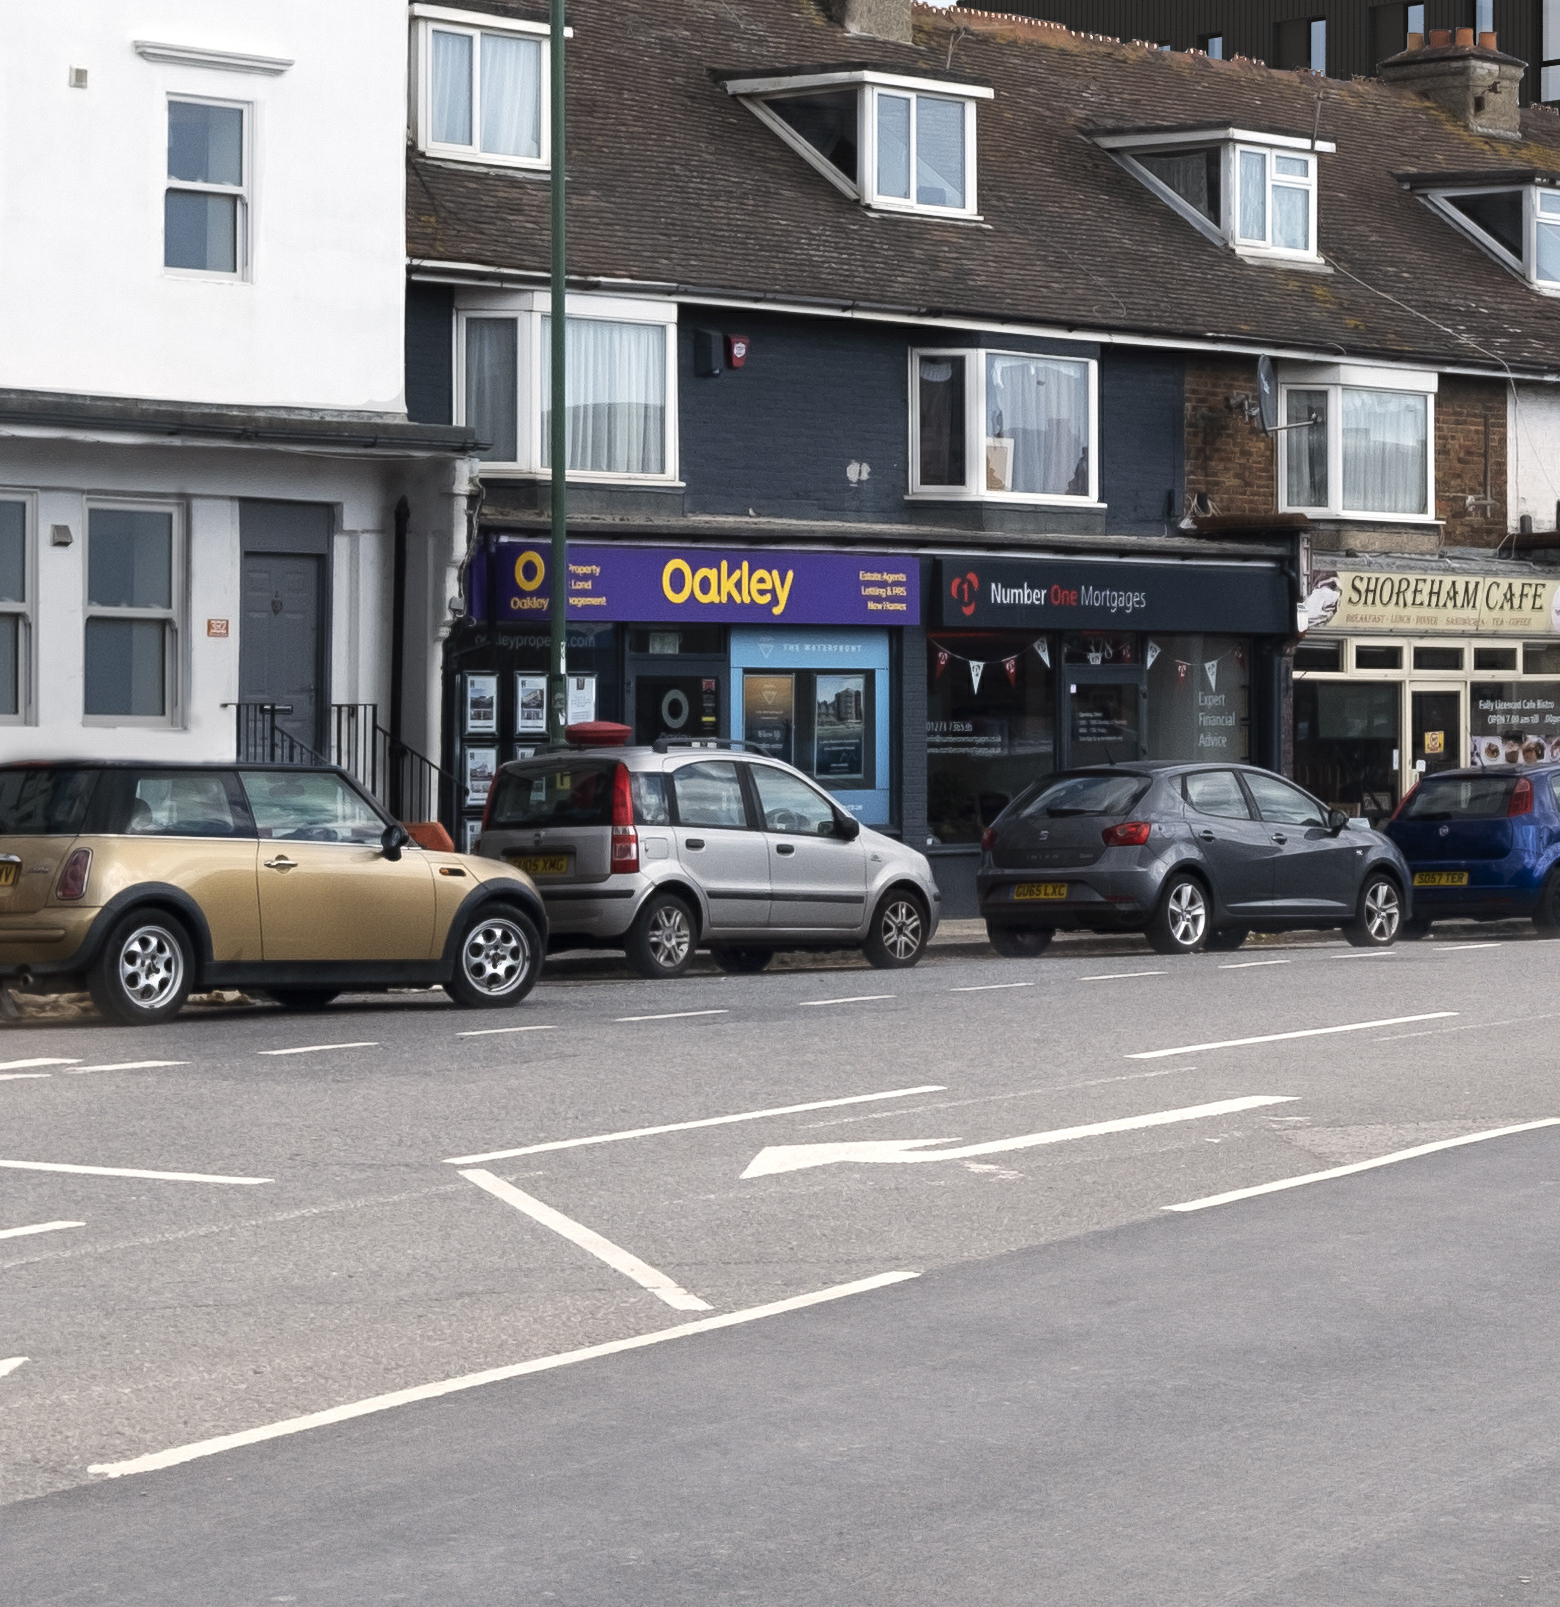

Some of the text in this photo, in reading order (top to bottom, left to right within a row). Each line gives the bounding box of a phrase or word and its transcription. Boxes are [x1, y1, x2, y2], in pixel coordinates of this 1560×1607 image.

[662, 558, 794, 615] Oakley
[1348, 575, 1547, 611] SHOREHAM CAFE
[510, 596, 550, 611] Oakley
[990, 582, 1147, 613] Number One Mortgages
[1198, 692, 1226, 710] Expert
[1198, 711, 1236, 727] Financial
[1198, 732, 1227, 748] Advice
